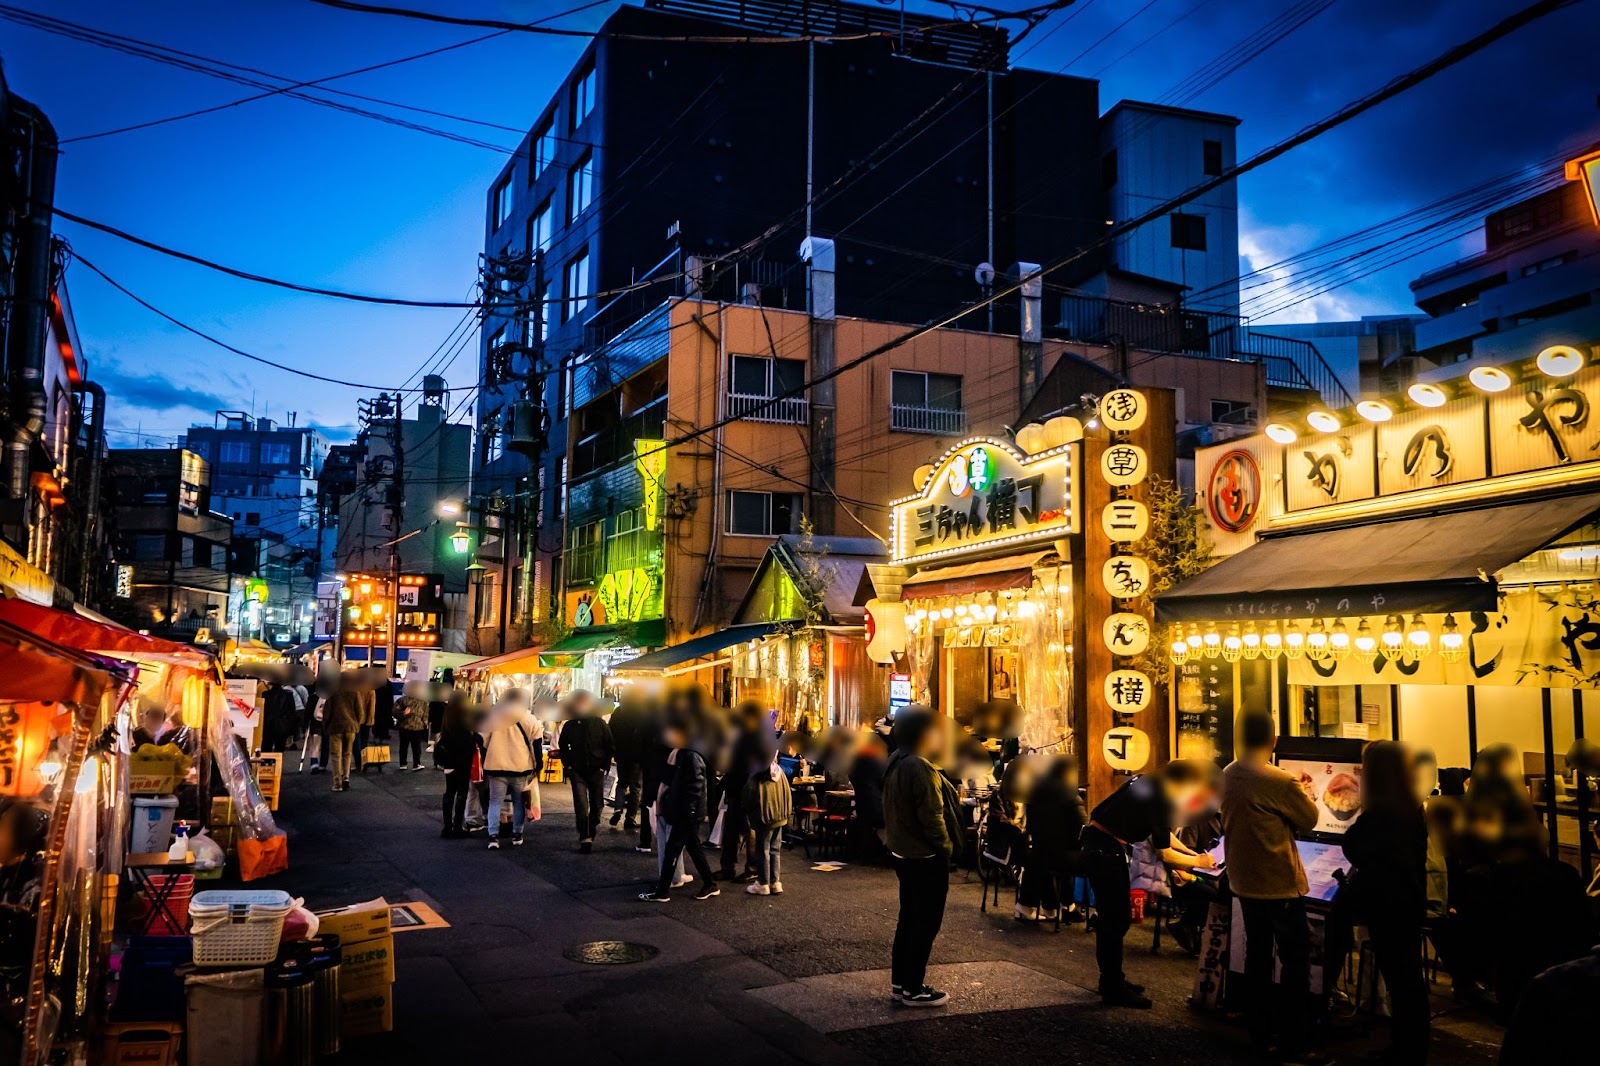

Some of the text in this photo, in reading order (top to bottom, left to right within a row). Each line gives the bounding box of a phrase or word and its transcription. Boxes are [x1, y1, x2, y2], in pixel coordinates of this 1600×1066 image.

[1304, 387, 1590, 498] かのや
[915, 473, 1045, 548] 三ちゃん横丁
[1106, 391, 1146, 760] 浅草三ちゃん横丁
